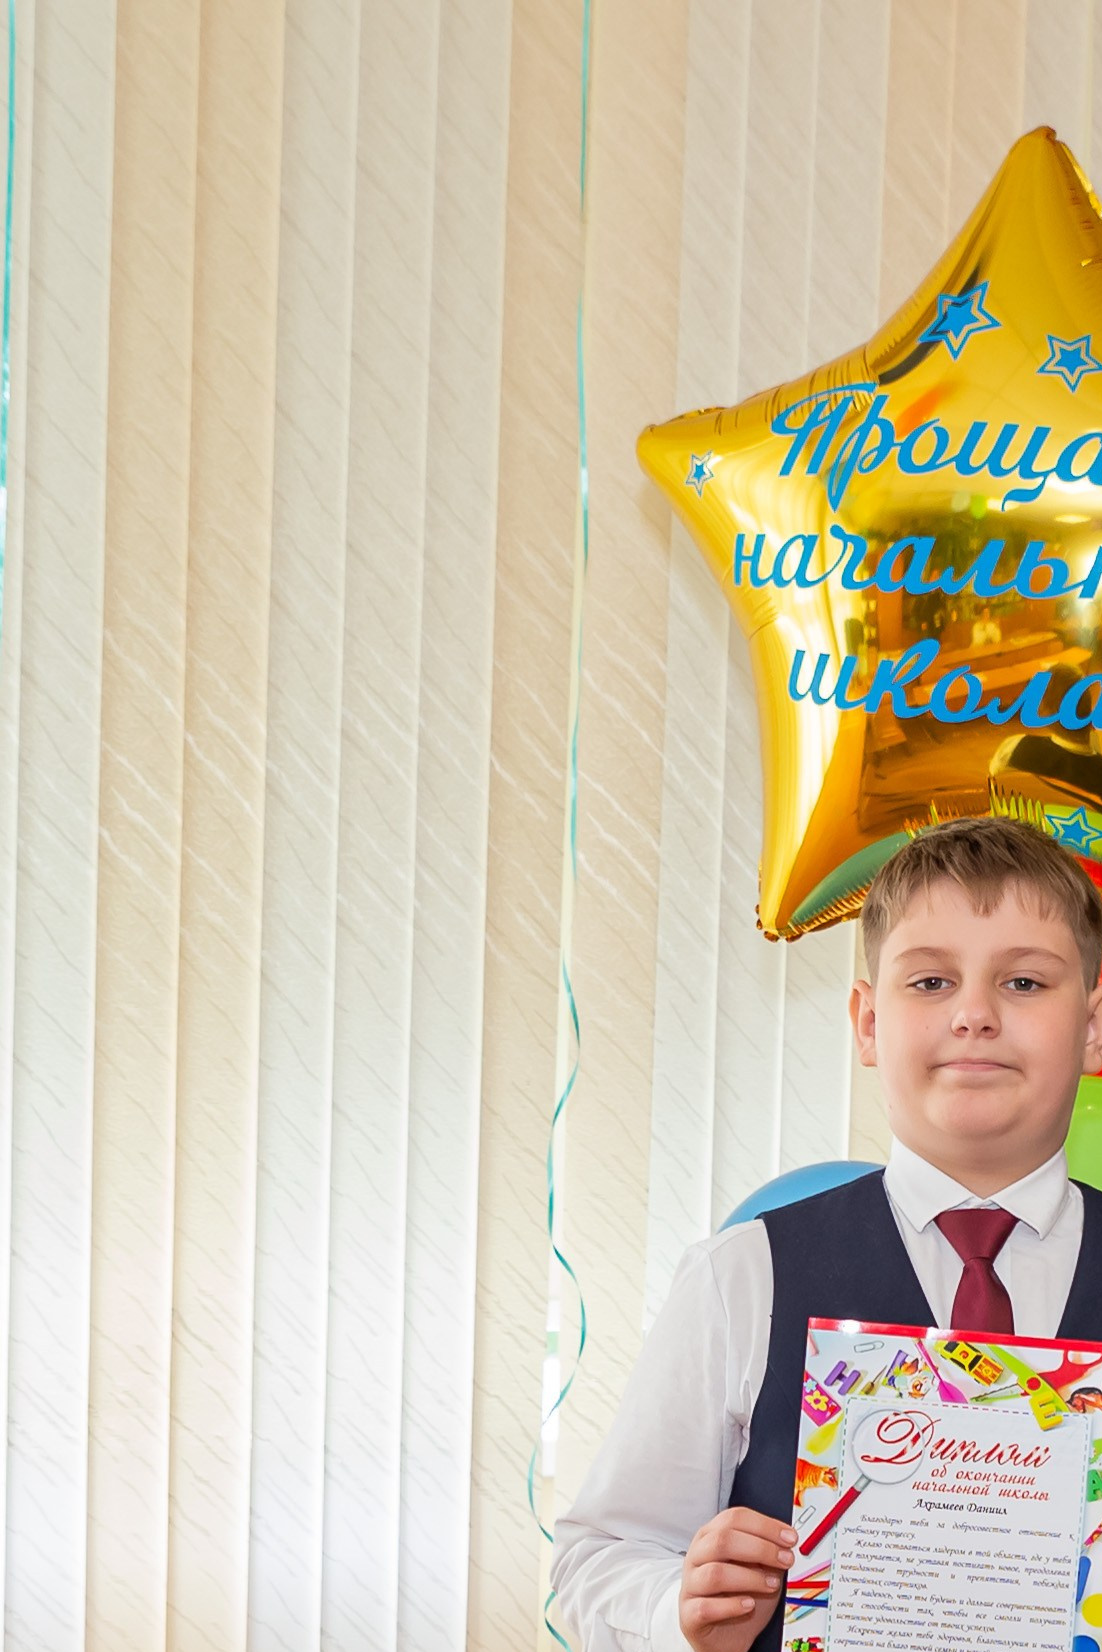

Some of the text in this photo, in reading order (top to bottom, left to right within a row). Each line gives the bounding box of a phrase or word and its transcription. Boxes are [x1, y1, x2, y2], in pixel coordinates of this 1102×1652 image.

[860, 1410, 1051, 1468] Диплом
[931, 1462, 1036, 1485] об окончании
[912, 1481, 1050, 1500] начальной школы
[967, 1502, 1008, 1515] Даниил
[842, 1526, 916, 1540] учебному процессу.
[860, 1515, 902, 1526] Благодарю
[910, 1519, 929, 1527] тебя
[953, 1522, 1011, 1533] добросовестное
[1019, 1529, 1061, 1537] отношение
[855, 1539, 882, 1548] Желаю
[885, 1543, 930, 1552] оставаться
[933, 1546, 965, 1556] лидером
[994, 1550, 1027, 1561] области,
[1031, 1553, 1042, 1561] где
[1053, 1555, 1071, 1563] тебя
[856, 1553, 902, 1563] получается,
[917, 1558, 949, 1566] уставая
[953, 1561, 995, 1570] постигать
[1025, 1567, 1070, 1576] преодолевая
[839, 1575, 882, 1586] достойных
[897, 1568, 939, 1578] трудности
[967, 1575, 1020, 1585] препятствия,
[1033, 1579, 1069, 1589] побеждая
[849, 1589, 859, 1597] Я
[861, 1589, 893, 1599] надеюсь,
[930, 1594, 956, 1605] будешь
[966, 1598, 994, 1607] дальше
[996, 1603, 1067, 1613] совершенствовать
[861, 1603, 909, 1612] способности
[943, 1609, 968, 1617] чтобы
[1030, 1618, 1066, 1626] получать
[874, 1617, 925, 1626] удовольствие
[941, 1623, 965, 1632] твоих
[834, 1638, 874, 1647] свершений
[887, 1640, 908, 1649] благо
[910, 1644, 932, 1652] твоей
[847, 1625, 883, 1635] Искренне
[937, 1633, 972, 1643] здоровья,
[977, 1636, 1028, 1648] благополучия
[1041, 1644, 1065, 1652] новых
